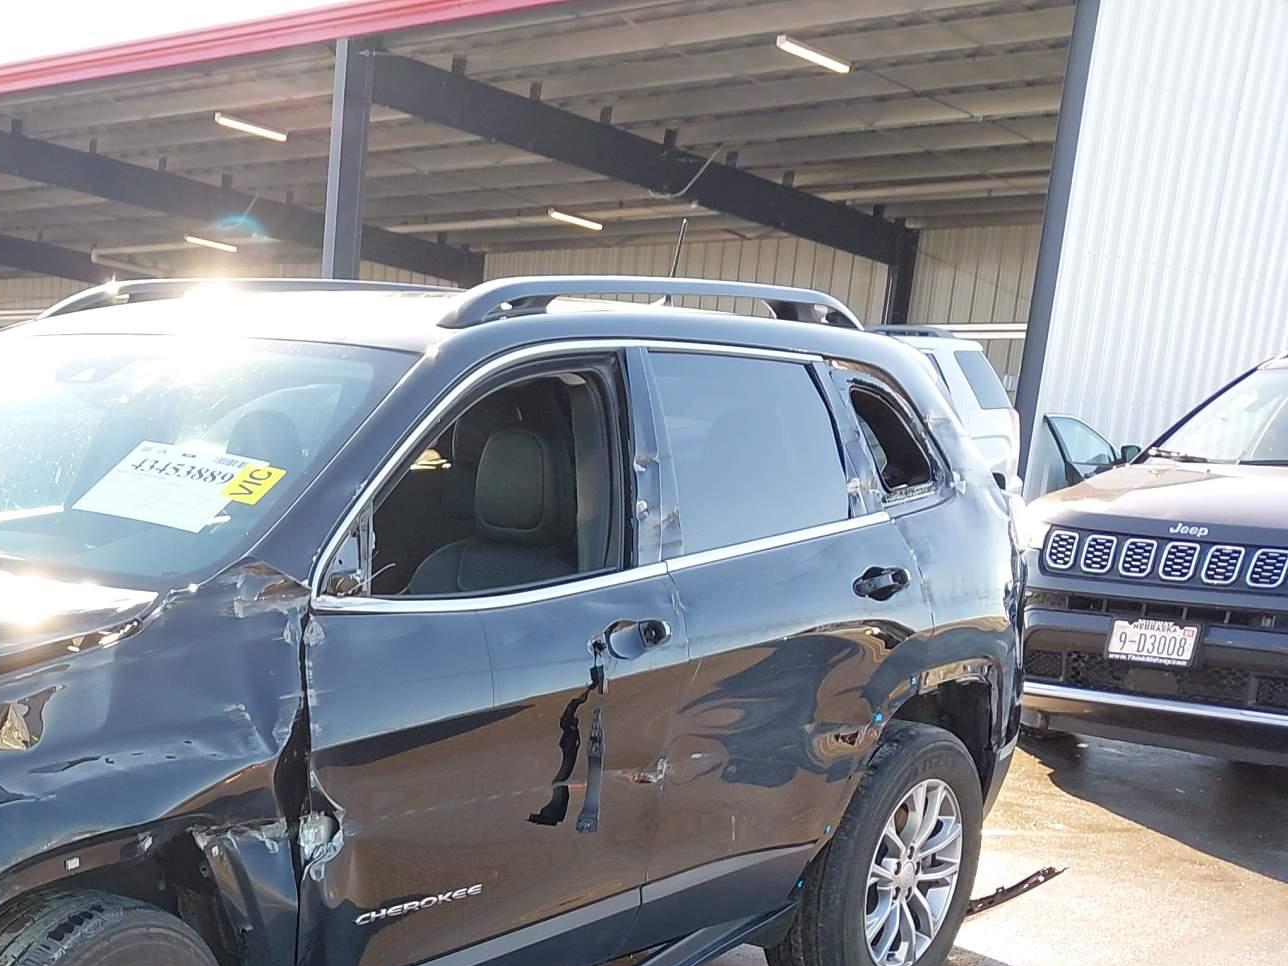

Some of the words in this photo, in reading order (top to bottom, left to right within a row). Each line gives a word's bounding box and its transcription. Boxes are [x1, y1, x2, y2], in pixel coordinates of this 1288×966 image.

[131, 458, 234, 485] 43453889
[228, 468, 273, 497] VIC
[1169, 522, 1209, 537] Jeep
[1133, 623, 1177, 633] NEBRASKA
[1119, 631, 1187, 657] 9-D3008
[354, 883, 484, 926] CHEROKEE
